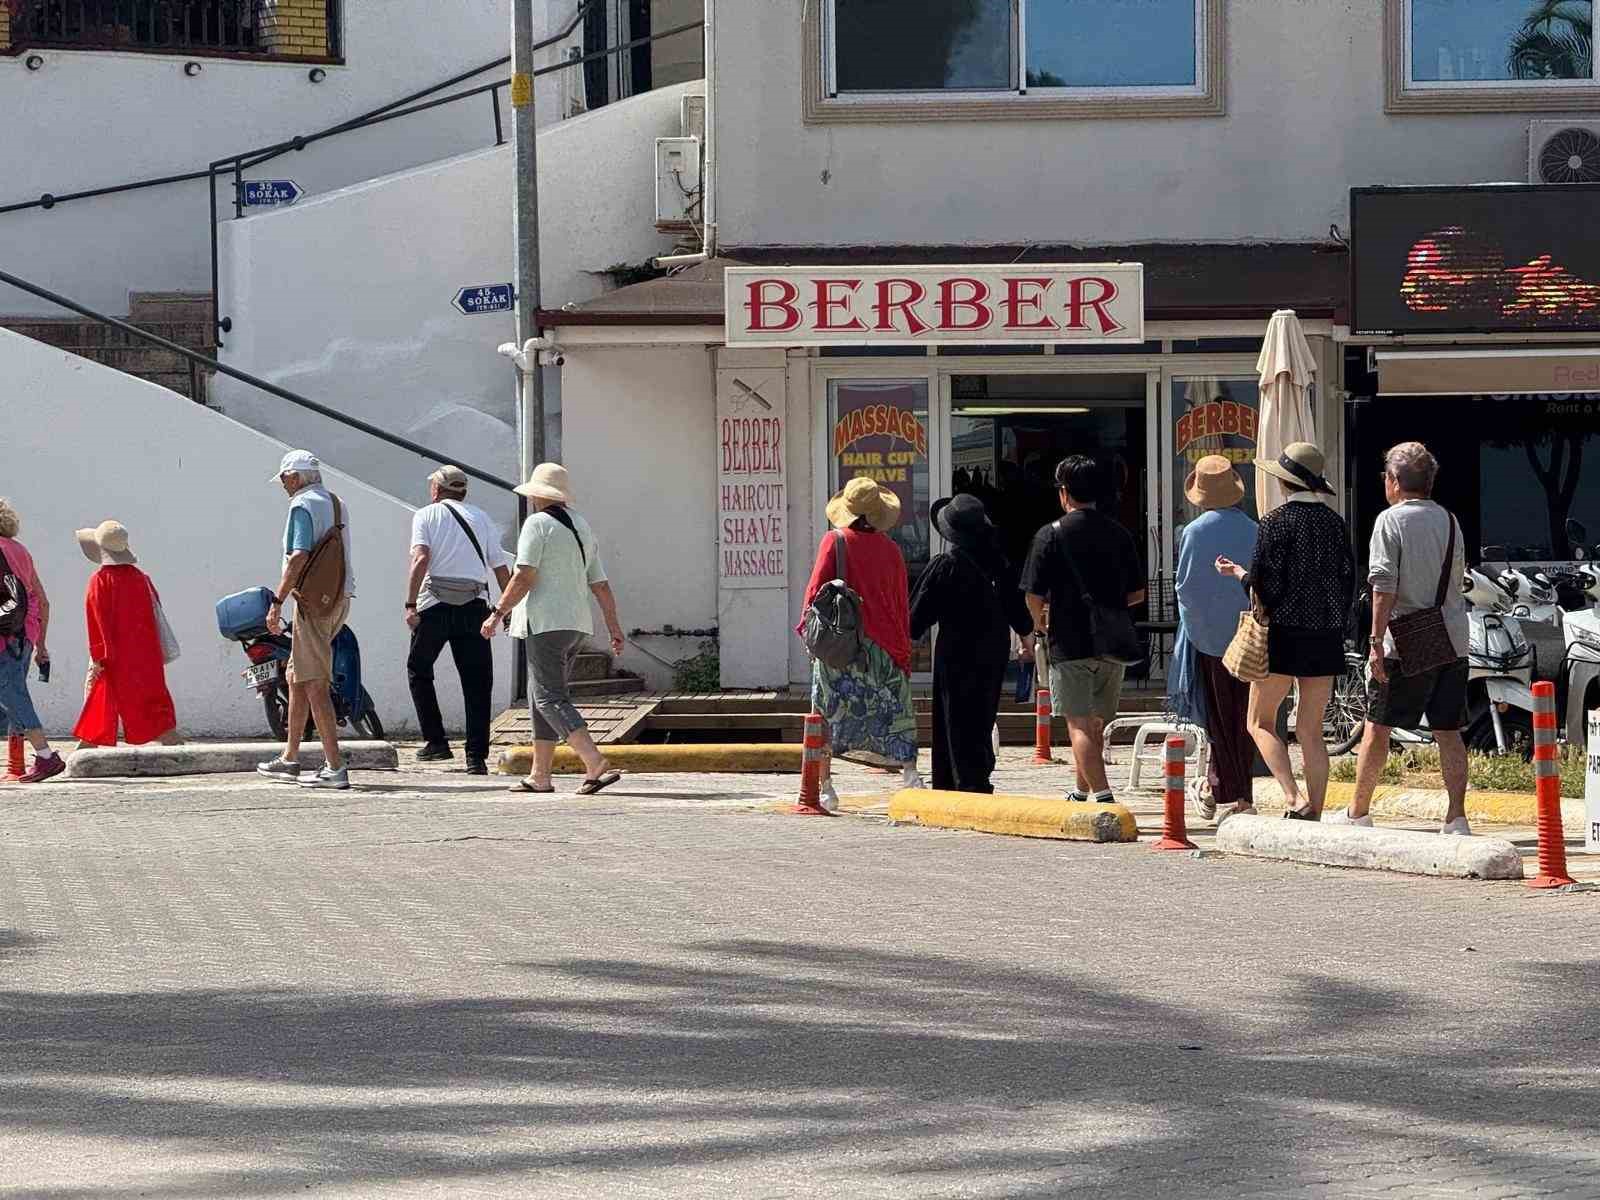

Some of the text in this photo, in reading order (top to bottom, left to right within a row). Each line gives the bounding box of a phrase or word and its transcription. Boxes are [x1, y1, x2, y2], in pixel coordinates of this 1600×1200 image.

[248, 190, 289, 199] SOKAK
[467, 294, 507, 306] SOKAK
[743, 277, 1126, 337] BERBER
[1546, 402, 1579, 413] Rent
[833, 404, 927, 459] MASSAGE
[721, 417, 782, 475] BERBER
[842, 451, 915, 465] HAIR CUT
[722, 484, 784, 511] HAIRCUT
[723, 514, 782, 544] SHAVE
[723, 549, 784, 577] MASSAGE
